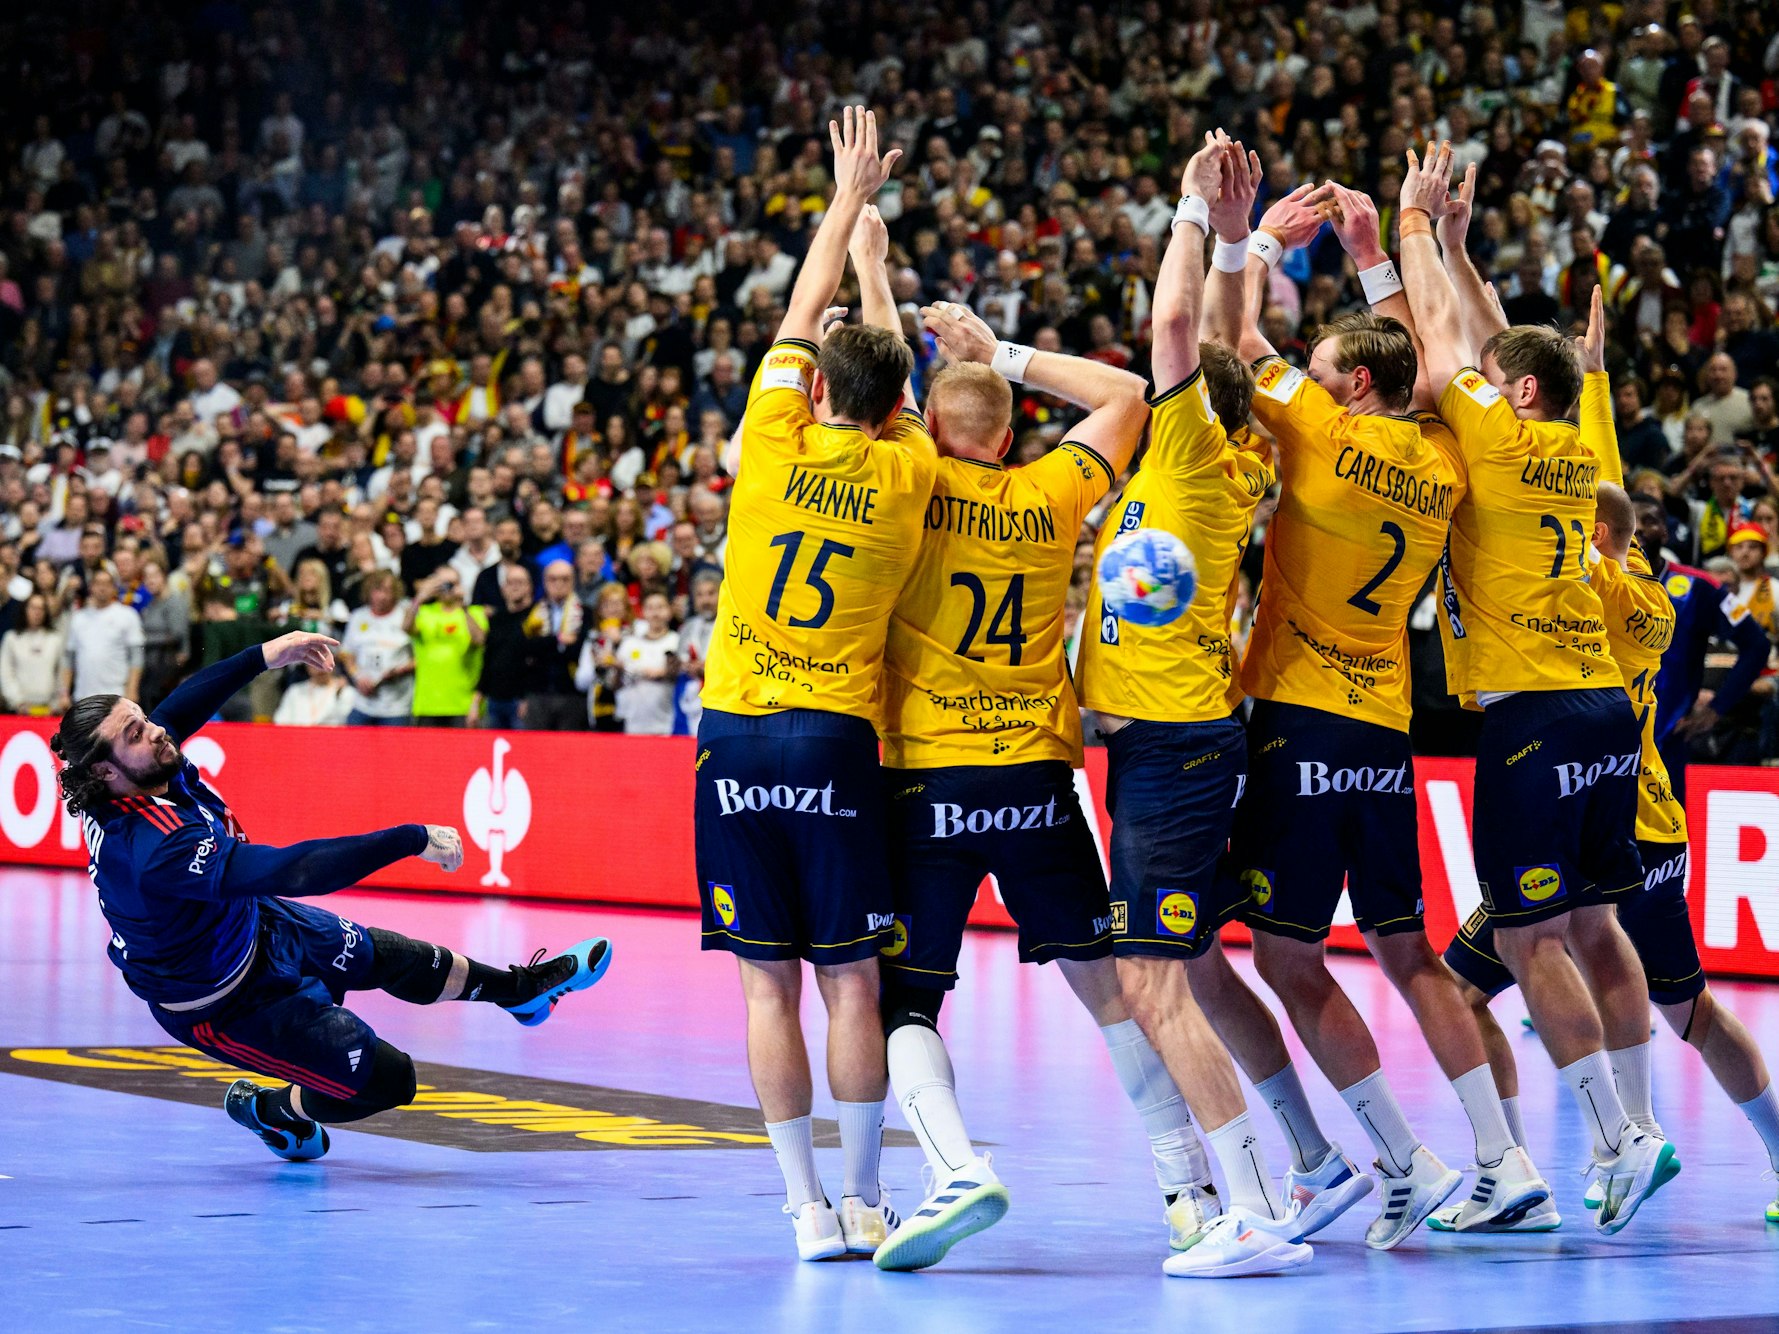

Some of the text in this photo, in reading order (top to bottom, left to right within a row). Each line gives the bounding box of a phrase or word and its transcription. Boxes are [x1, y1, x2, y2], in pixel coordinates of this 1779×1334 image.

[784, 465, 878, 525] WANNE
[923, 495, 1056, 543] OTTFRIDSON
[765, 530, 855, 629] 15
[1346, 520, 1406, 617] 2
[950, 571, 1028, 667] 24
[1511, 614, 1606, 634] Sparbanke
[729, 615, 849, 675] Spbanken
[1288, 620, 1399, 673] arbanken
[1183, 752, 1213, 771] CRAFT
[1506, 743, 1533, 766] CRAFT
[1641, 852, 1686, 891] ooz
[866, 912, 895, 931] Booz
